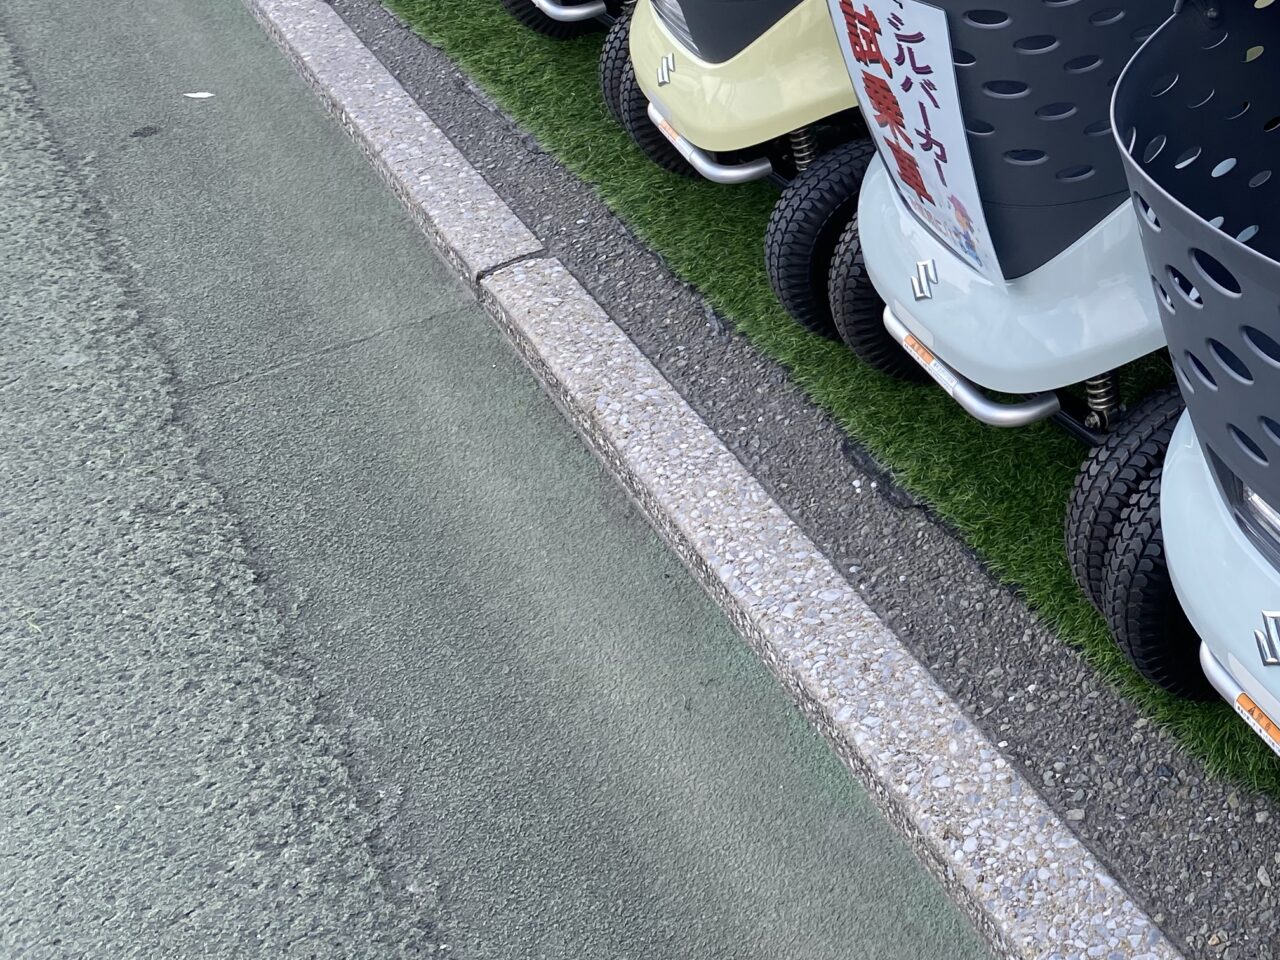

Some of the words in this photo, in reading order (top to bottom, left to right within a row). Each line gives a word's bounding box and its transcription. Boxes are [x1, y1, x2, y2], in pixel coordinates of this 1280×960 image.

[887, 12, 948, 188] シルバーカー
